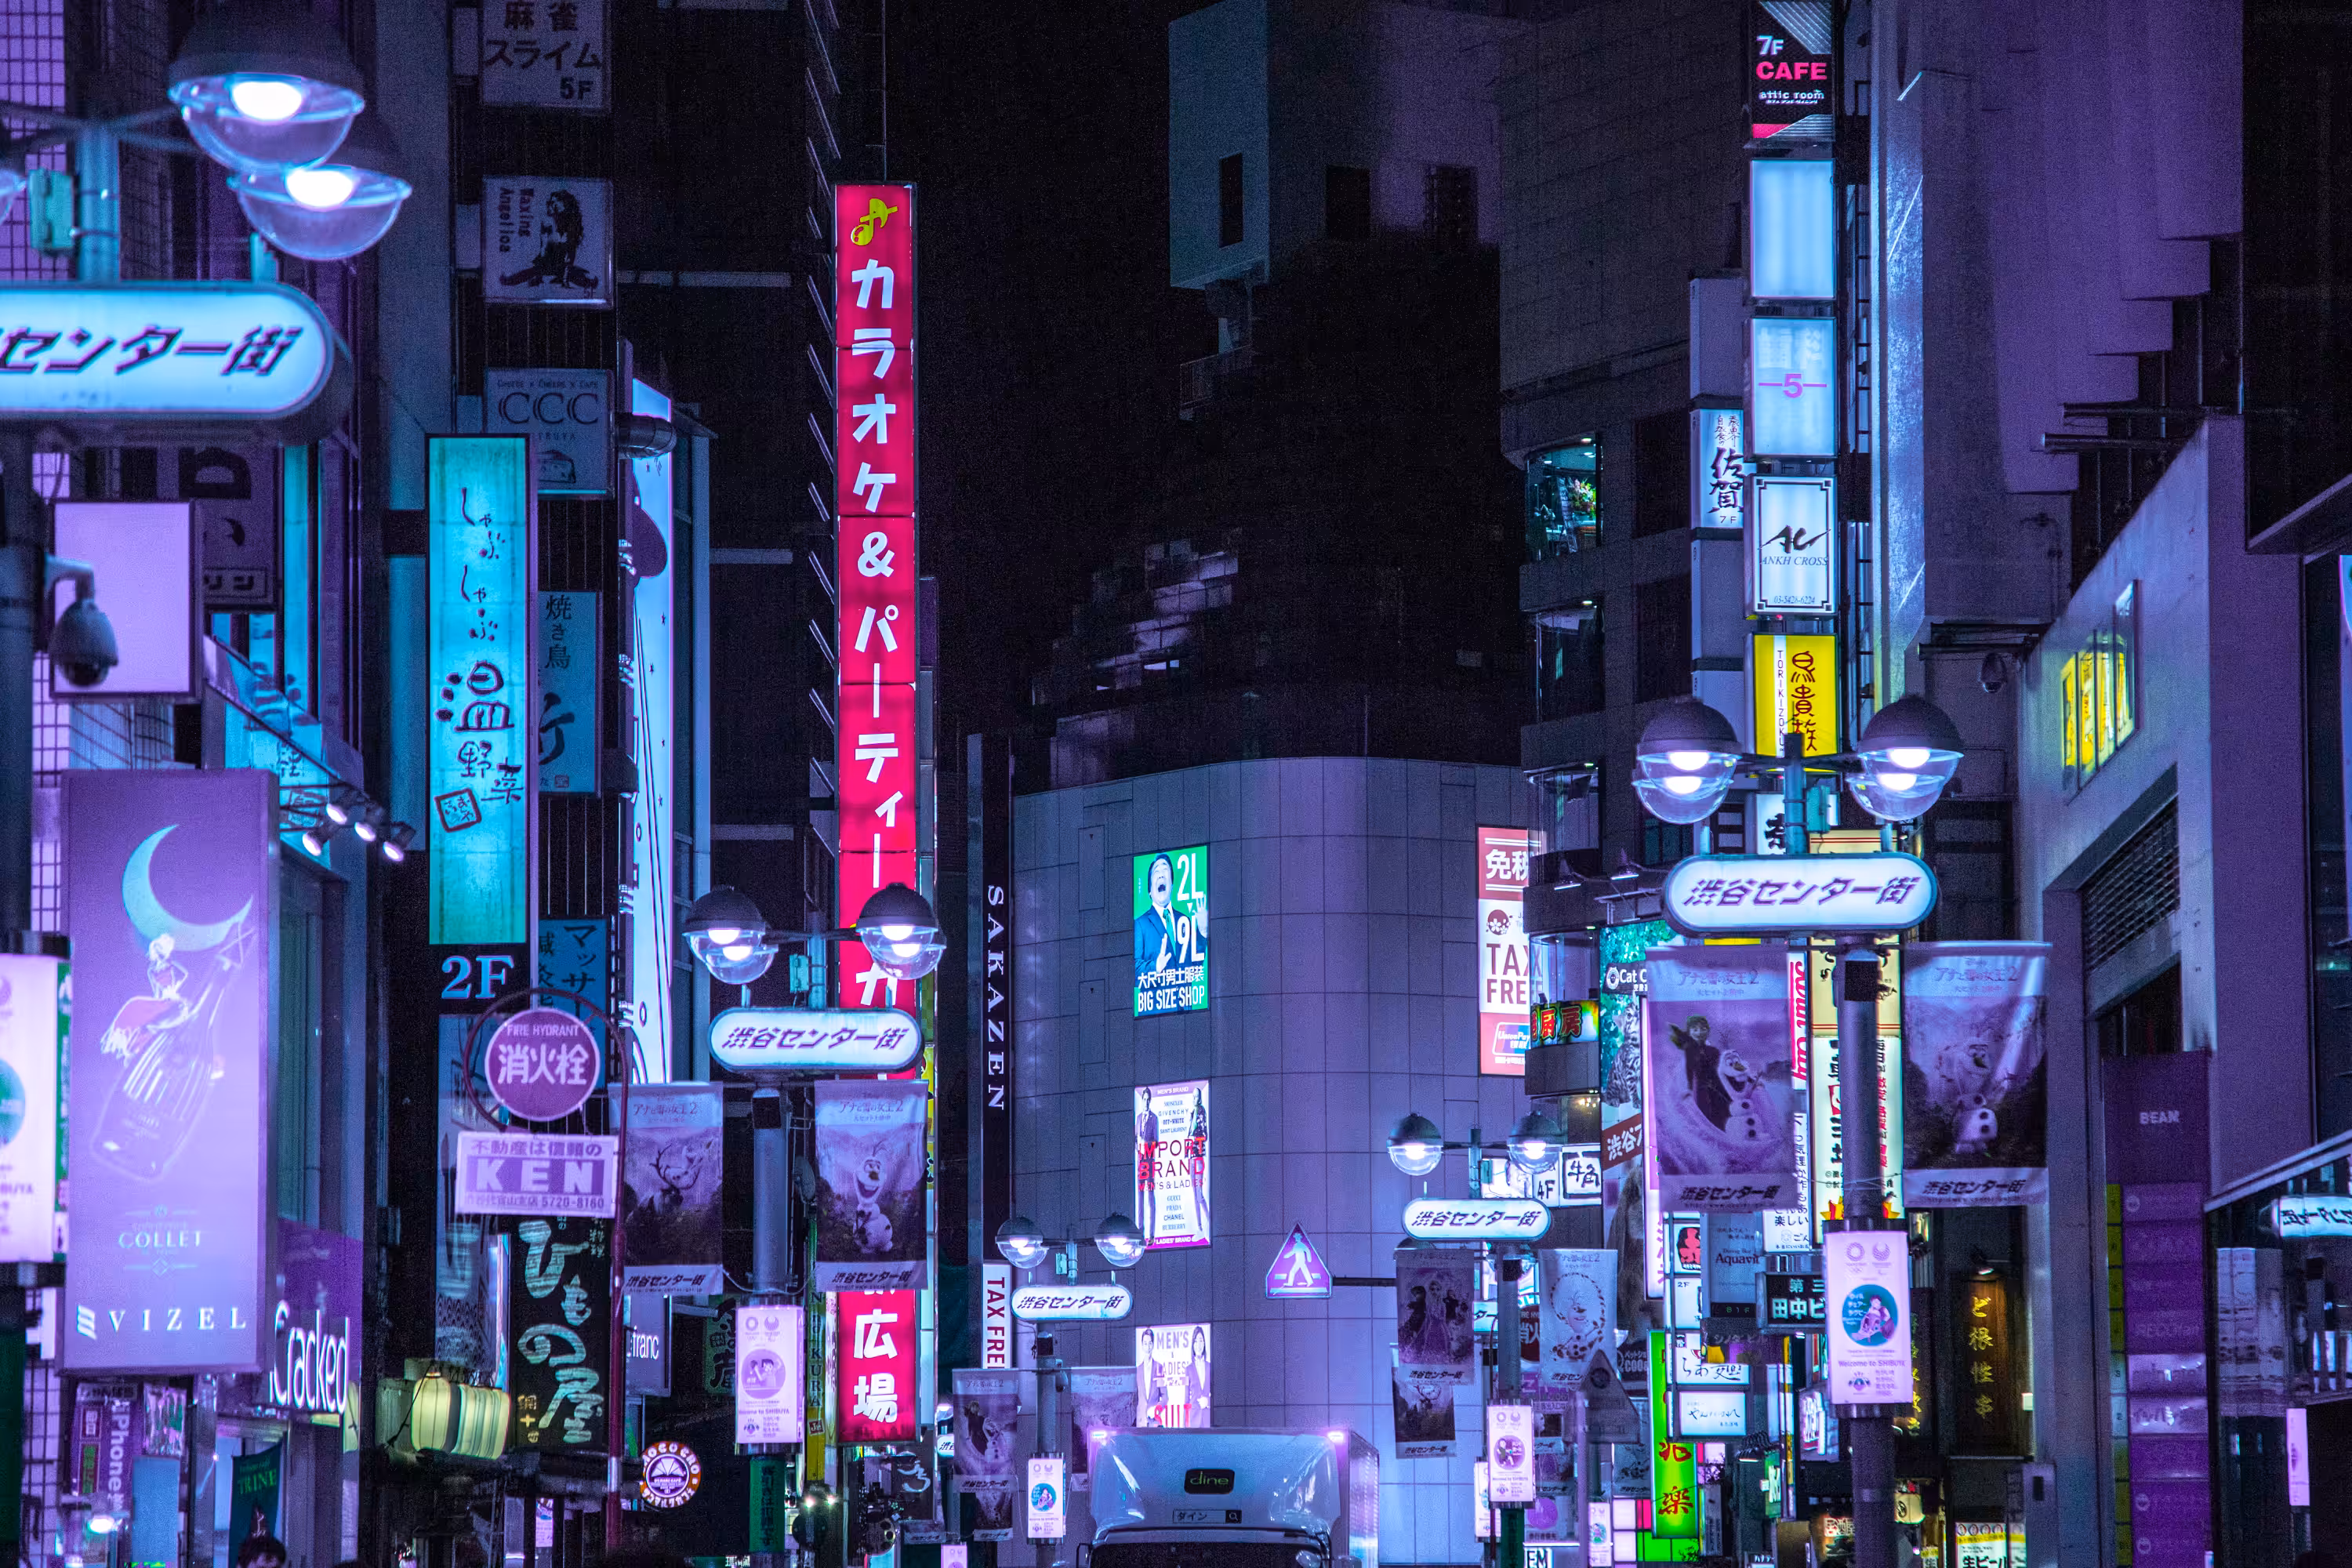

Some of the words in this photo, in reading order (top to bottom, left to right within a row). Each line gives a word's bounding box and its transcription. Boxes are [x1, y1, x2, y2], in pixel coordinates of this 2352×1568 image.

[485, 39, 604, 71] スライム
[1756, 34, 1784, 56] 7F
[1755, 61, 1828, 81] CAFE
[559, 75, 593, 100] 5F
[1759, 89, 1790, 100] attic
[1793, 89, 1825, 100] room
[0, 323, 303, 376] センター街
[1782, 373, 1804, 398] 5
[497, 391, 600, 426] CCC
[1705, 446, 1744, 514] 佐賀
[1719, 514, 1737, 524] 7F
[1762, 555, 1792, 566] ANKH
[1793, 556, 1828, 567] CROSS
[544, 593, 573, 670] 焼き鳥
[1777, 649, 1786, 747] TORIKIZOKU
[1177, 852, 1204, 901] 2L
[1682, 875, 1922, 908] 渋谷センター街
[1177, 914, 1205, 964] 9L
[441, 954, 515, 1000] 2F
[1620, 969, 1638, 983] Cat
[988, 884, 1004, 1111] SAKAZEN
[1138, 991, 1154, 1013] BIG
[1156, 988, 1178, 1010] SIZE
[1178, 985, 1206, 1007] SHOP
[532, 1024, 579, 1036] HYDRANT
[722, 1026, 909, 1050] 渋谷センター街
[497, 1043, 590, 1085] 消火栓
[1158, 1108, 1189, 1117] GIVENCHY
[1138, 1136, 1207, 1161] IMPORT
[475, 1158, 593, 1193] KEN
[1138, 1156, 1206, 1181] BRAND
[1567, 1160, 1601, 1189] 牛角
[1138, 1181, 1164, 1192] MEN'S
[1166, 1181, 1172, 1189] &
[1537, 1179, 1556, 1200] 4F
[1679, 1183, 1782, 1203] 渋谷センター街
[1923, 1178, 2026, 1196] 渋谷センター街
[1163, 1213, 1185, 1221] CHANEL
[1410, 1210, 1542, 1229] 渋谷センター街
[118, 1231, 202, 1248] COLLET
[1715, 1253, 1760, 1266] Aquavit
[831, 1271, 912, 1284] 渋谷センター街
[986, 1276, 1005, 1319] TAX
[1017, 1296, 1125, 1310] 渋谷センター街
[108, 1307, 247, 1332] VIZEL
[986, 1326, 1005, 1369] FRE
[1156, 1330, 1189, 1350] MEN'S
[270, 1301, 350, 1414] Cracked
[852, 1308, 899, 1424] 広場
[1156, 1361, 1189, 1377] LADIES'
[1189, 1470, 1229, 1486] dine
[1176, 1511, 1208, 1523] ダイン
